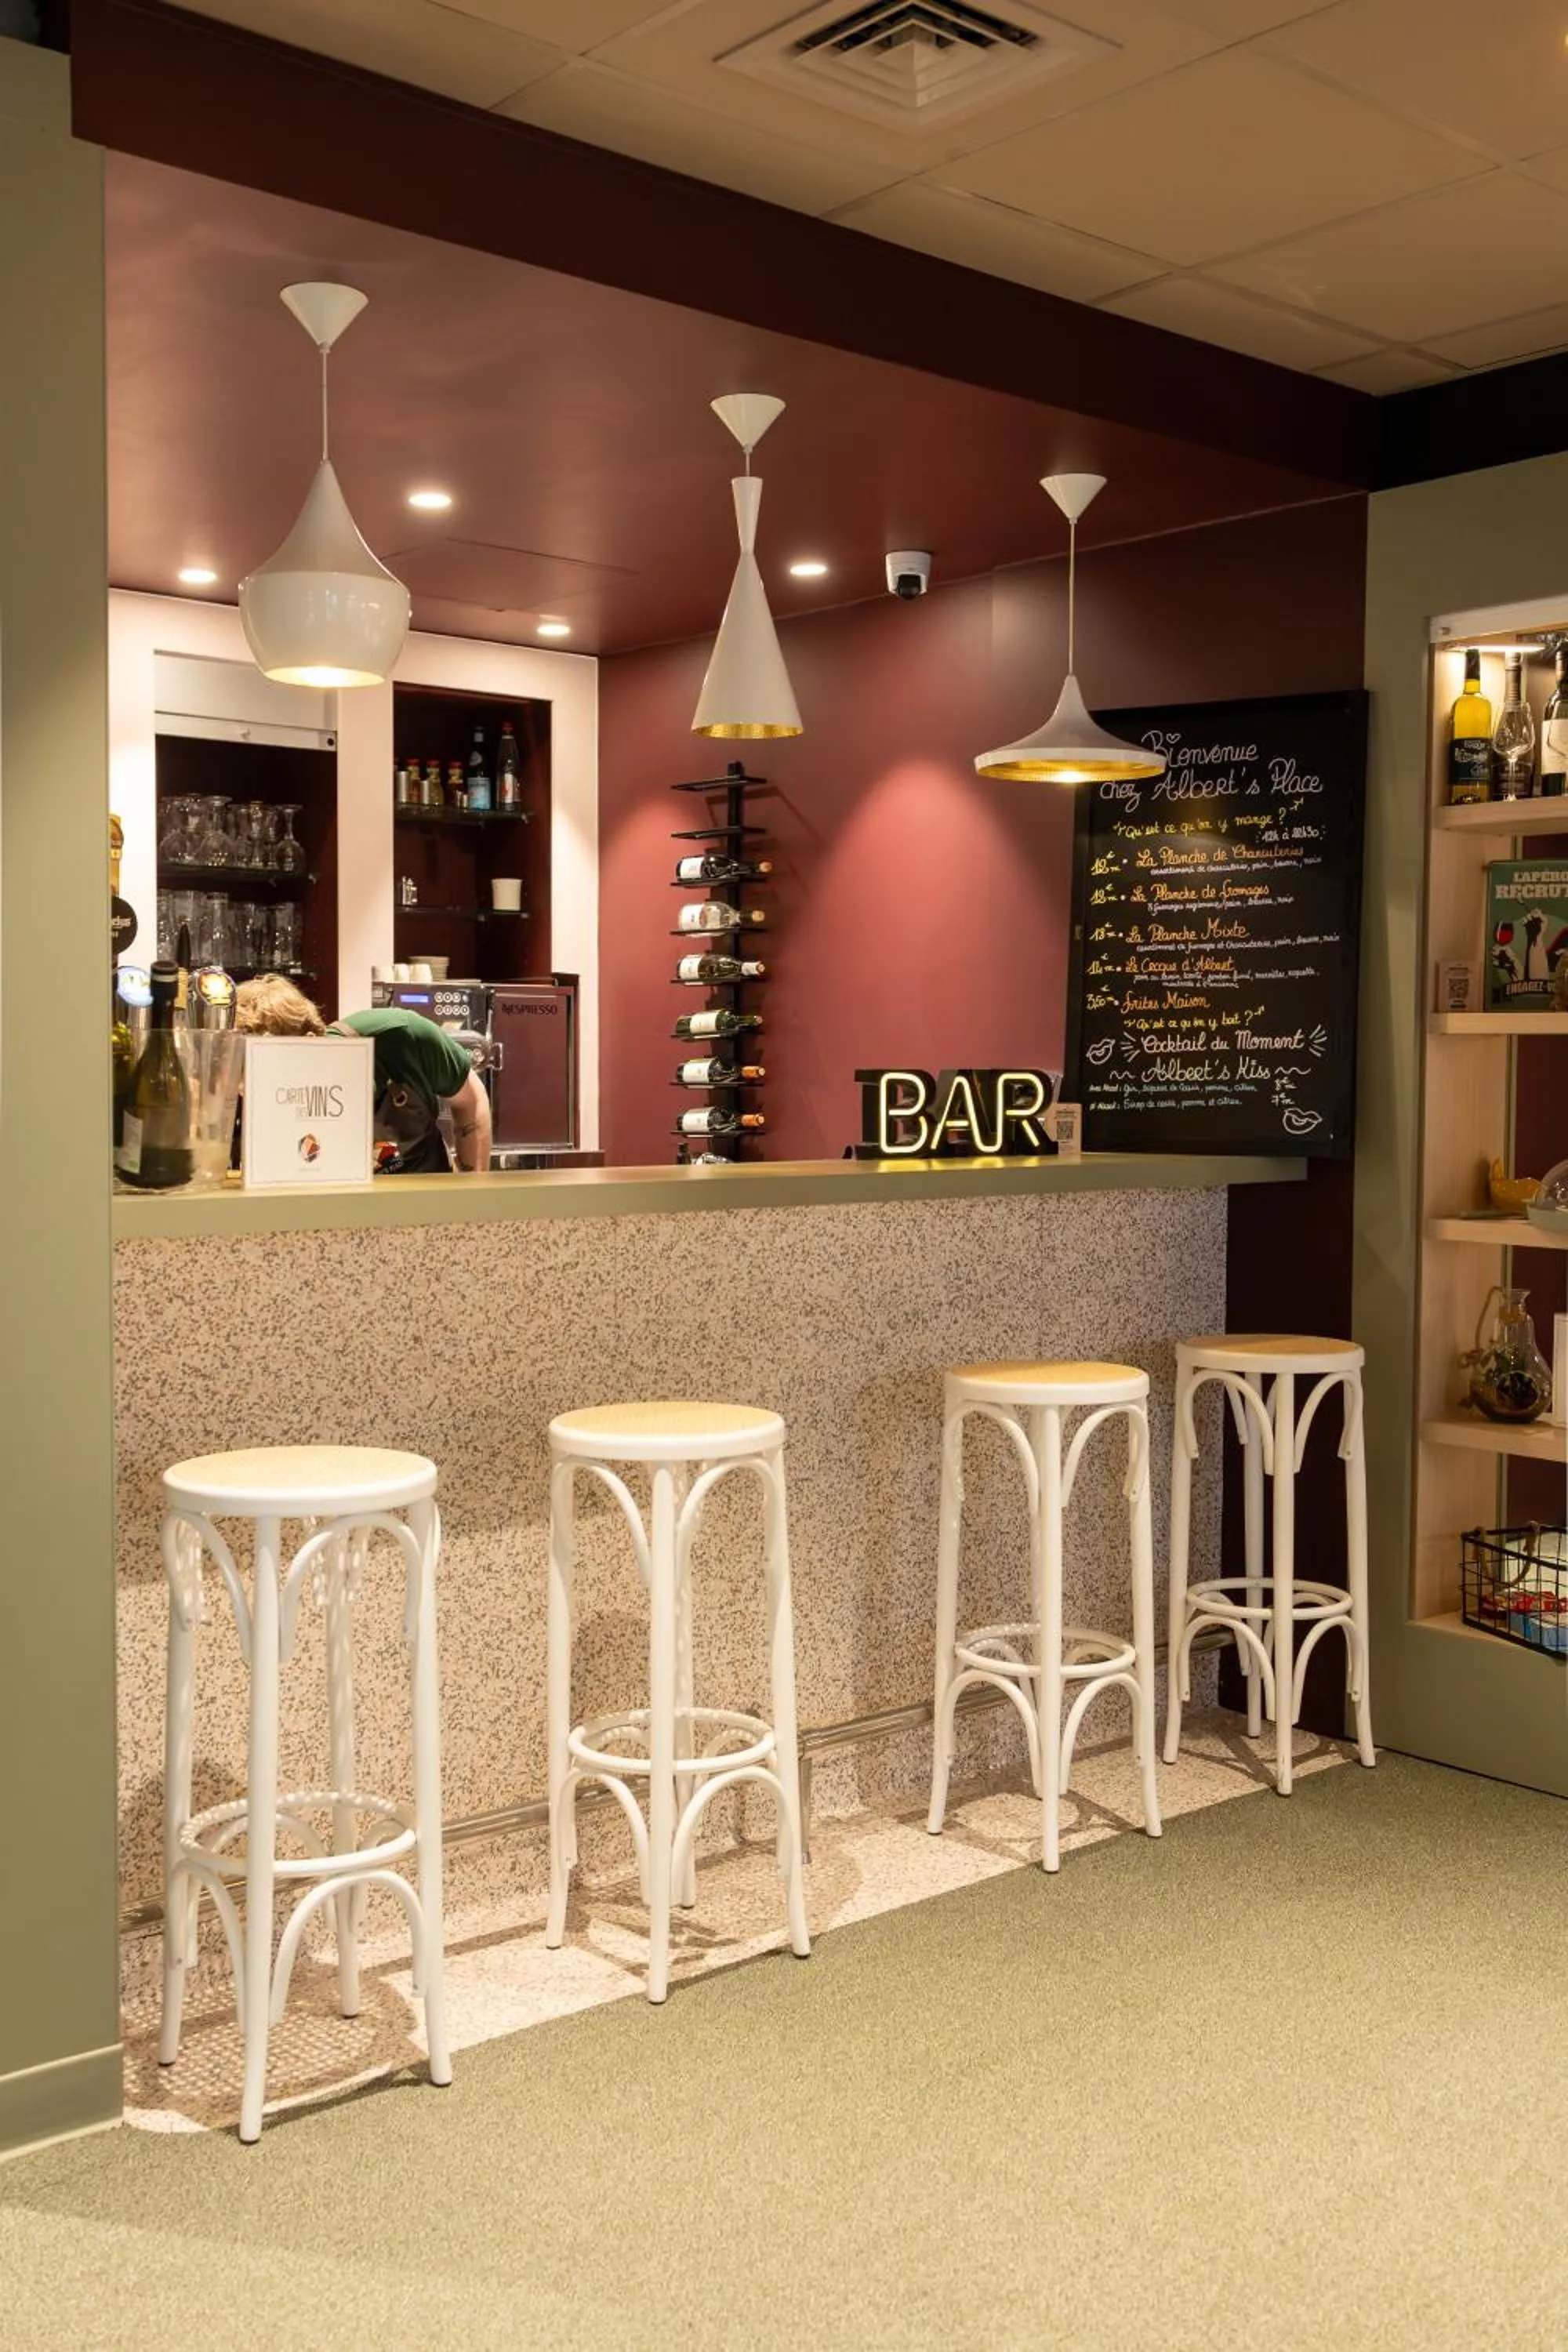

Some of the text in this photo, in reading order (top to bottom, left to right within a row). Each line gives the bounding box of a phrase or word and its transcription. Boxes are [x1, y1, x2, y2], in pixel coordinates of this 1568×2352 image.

[1141, 729, 1259, 768] Bienvenue
[1268, 757, 1323, 795] Place
[1235, 813, 1273, 829] mange
[1159, 846, 1209, 866] Planche
[1213, 847, 1228, 862] de
[1150, 882, 1199, 902] Planche
[1201, 884, 1216, 899] de
[1147, 923, 1198, 942] Planche
[502, 1003, 557, 1016] NESPRESSO
[1162, 991, 1211, 1009] Maison
[1141, 1028, 1305, 1054] Cocktail du Moment
[1235, 1055, 1272, 1080] Kiss
[275, 1087, 306, 1105] CARTE
[305, 1084, 344, 1117] VINS
[877, 1070, 1047, 1156] BAR
